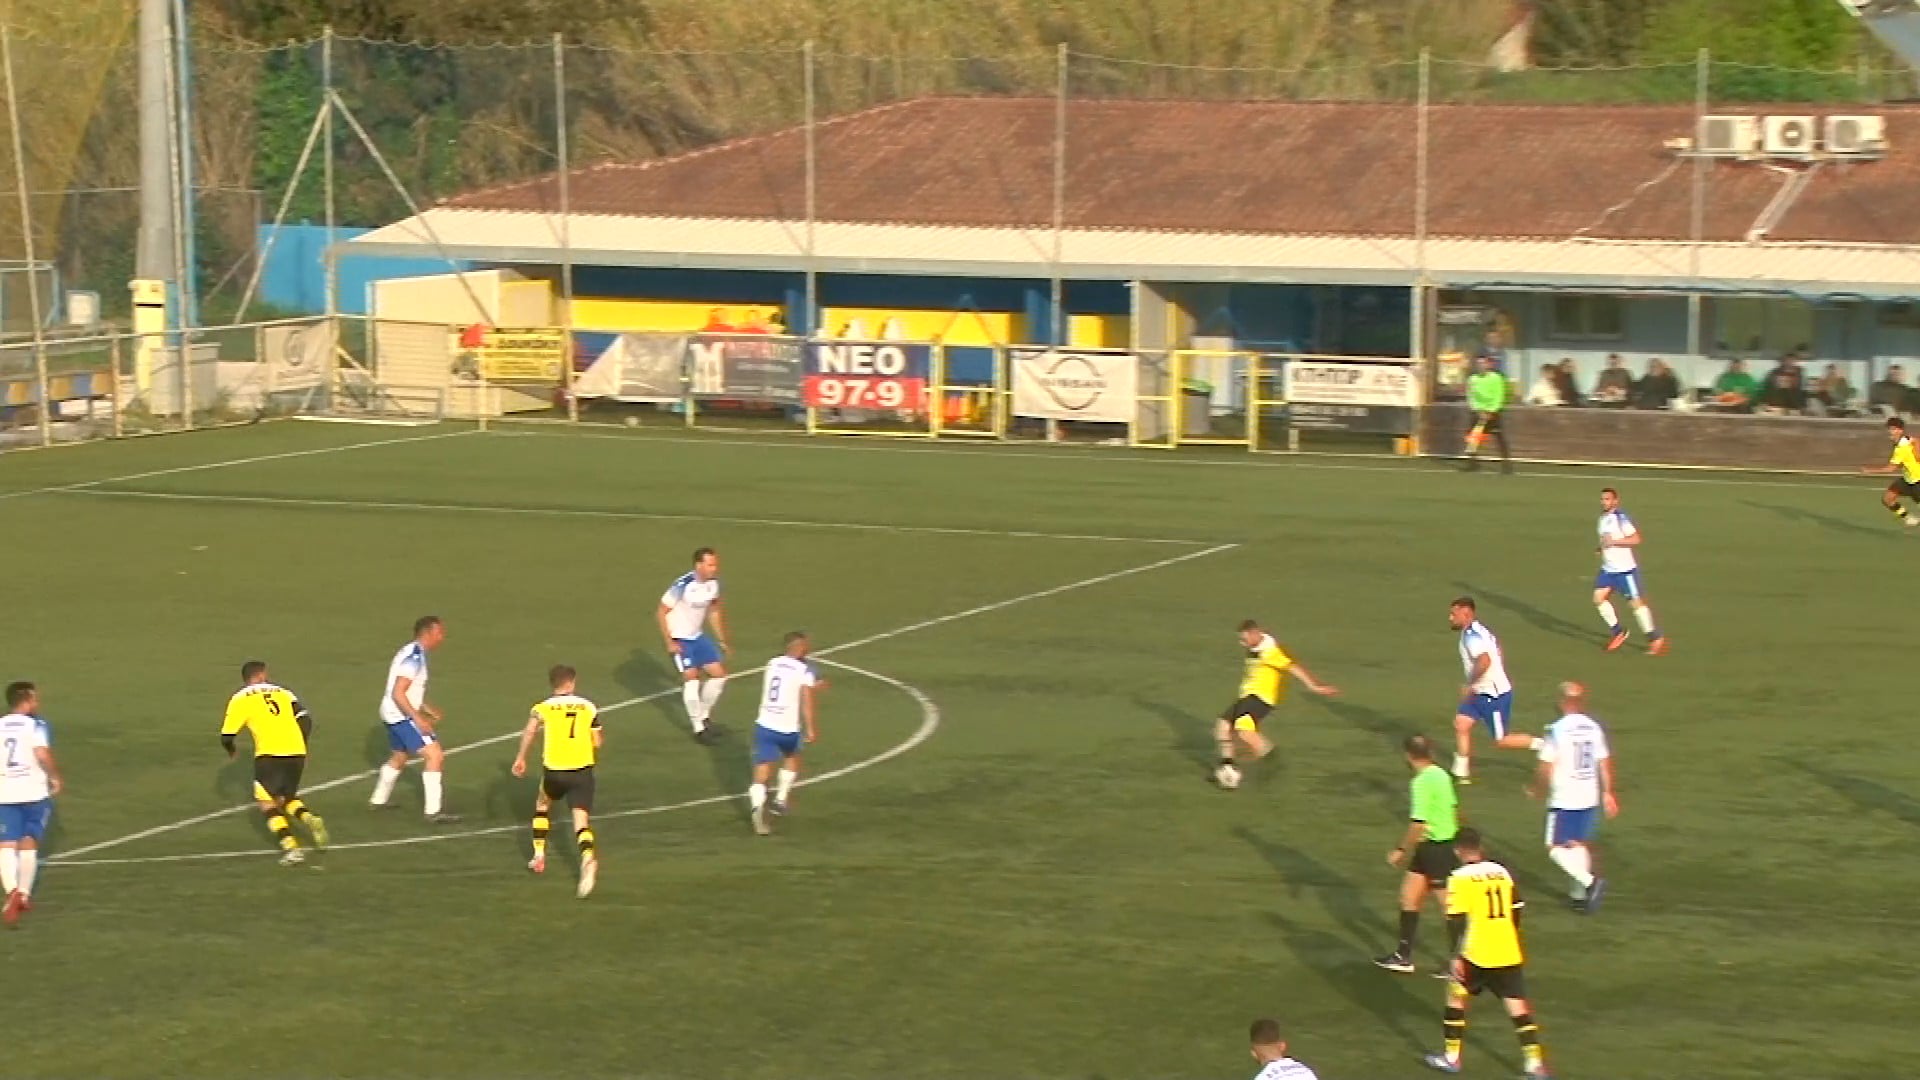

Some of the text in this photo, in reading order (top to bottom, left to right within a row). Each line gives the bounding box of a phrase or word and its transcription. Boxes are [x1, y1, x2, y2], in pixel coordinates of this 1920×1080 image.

[818, 345, 906, 375] NEO
[768, 675, 781, 703] 8
[262, 693, 280, 717] 5
[565, 711, 577, 739] 7
[4, 737, 19, 768] 2
[1484, 885, 1506, 920] 11
